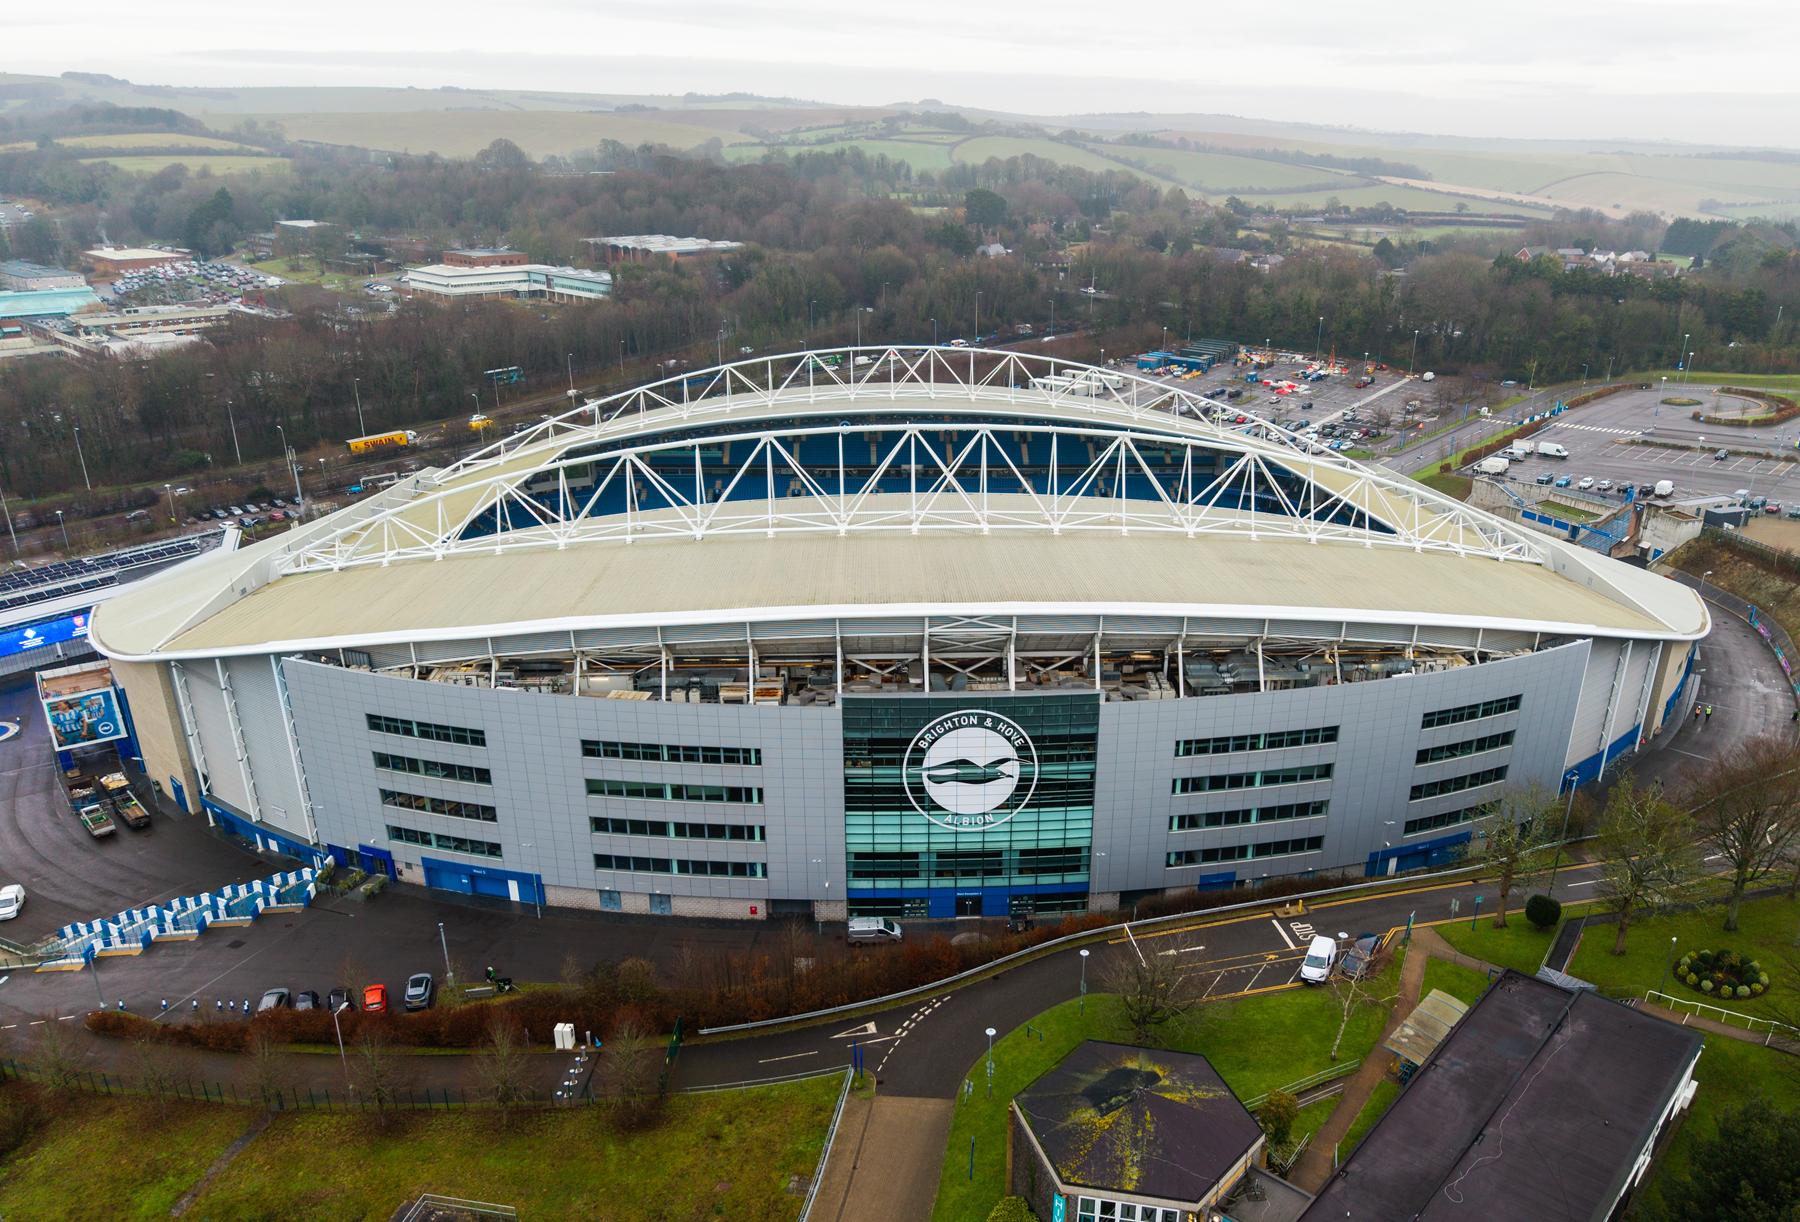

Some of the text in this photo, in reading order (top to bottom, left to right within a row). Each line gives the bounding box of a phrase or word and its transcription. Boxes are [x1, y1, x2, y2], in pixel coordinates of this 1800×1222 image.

[364, 437, 394, 448] SWAIN
[918, 715, 1025, 749] BRIGHTON & HOVE
[944, 813, 994, 827] ALBION
[1290, 922, 1319, 941] STOP
